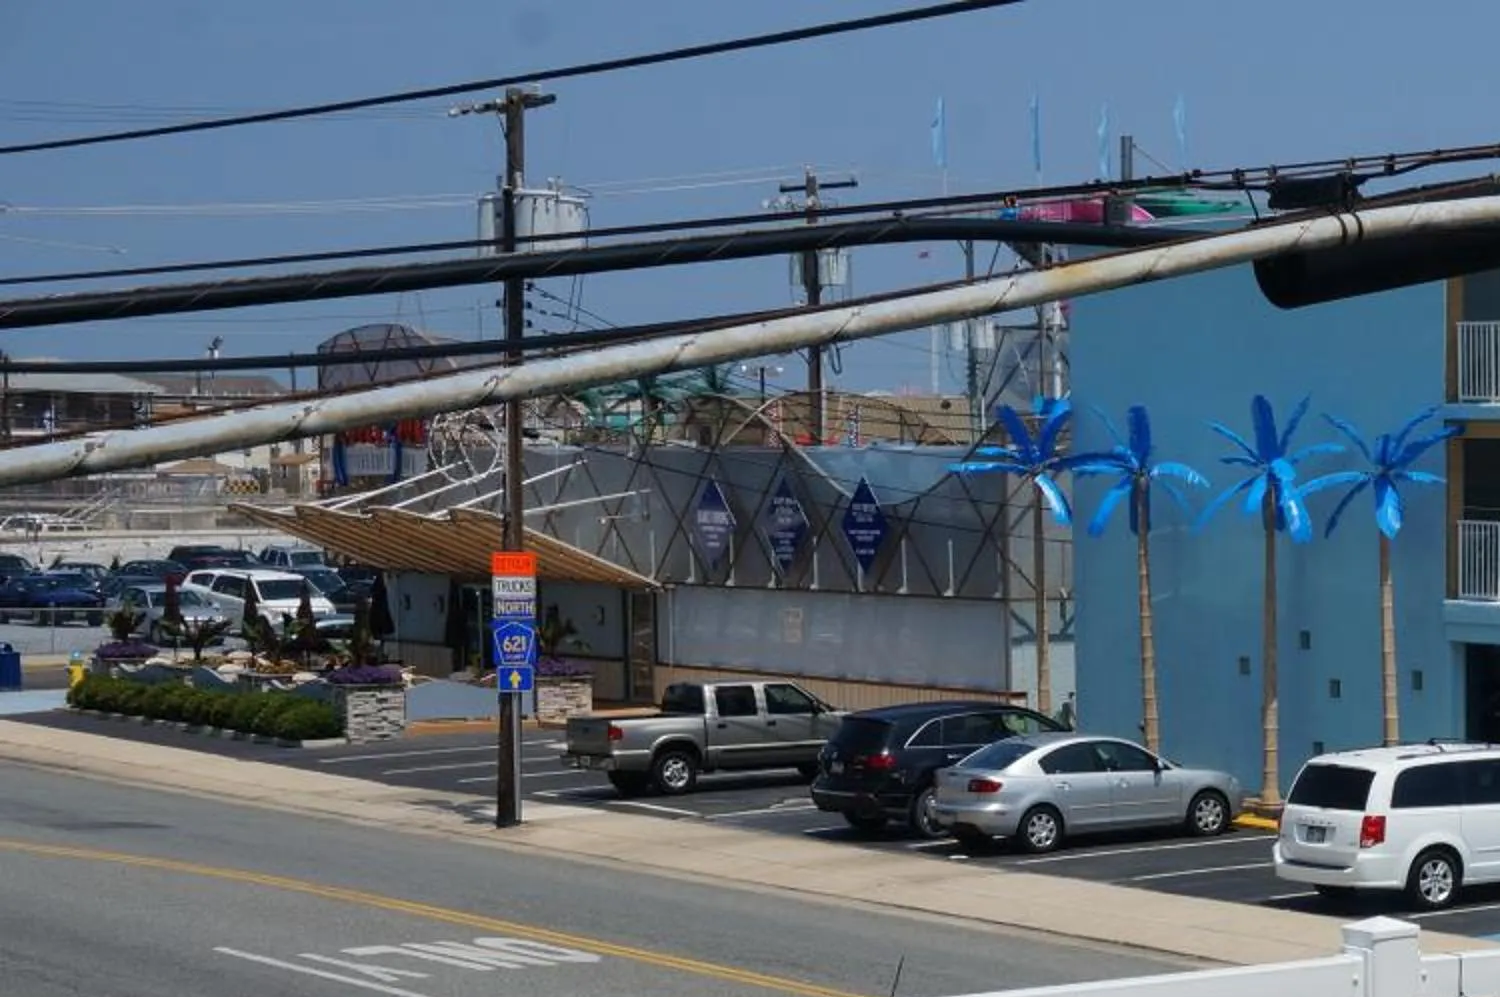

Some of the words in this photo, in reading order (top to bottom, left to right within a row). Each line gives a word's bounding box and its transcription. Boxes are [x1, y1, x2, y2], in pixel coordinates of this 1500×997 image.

[496, 580, 534, 593] TRUCKS
[497, 600, 535, 615] NORTH
[503, 635, 527, 652] 621
